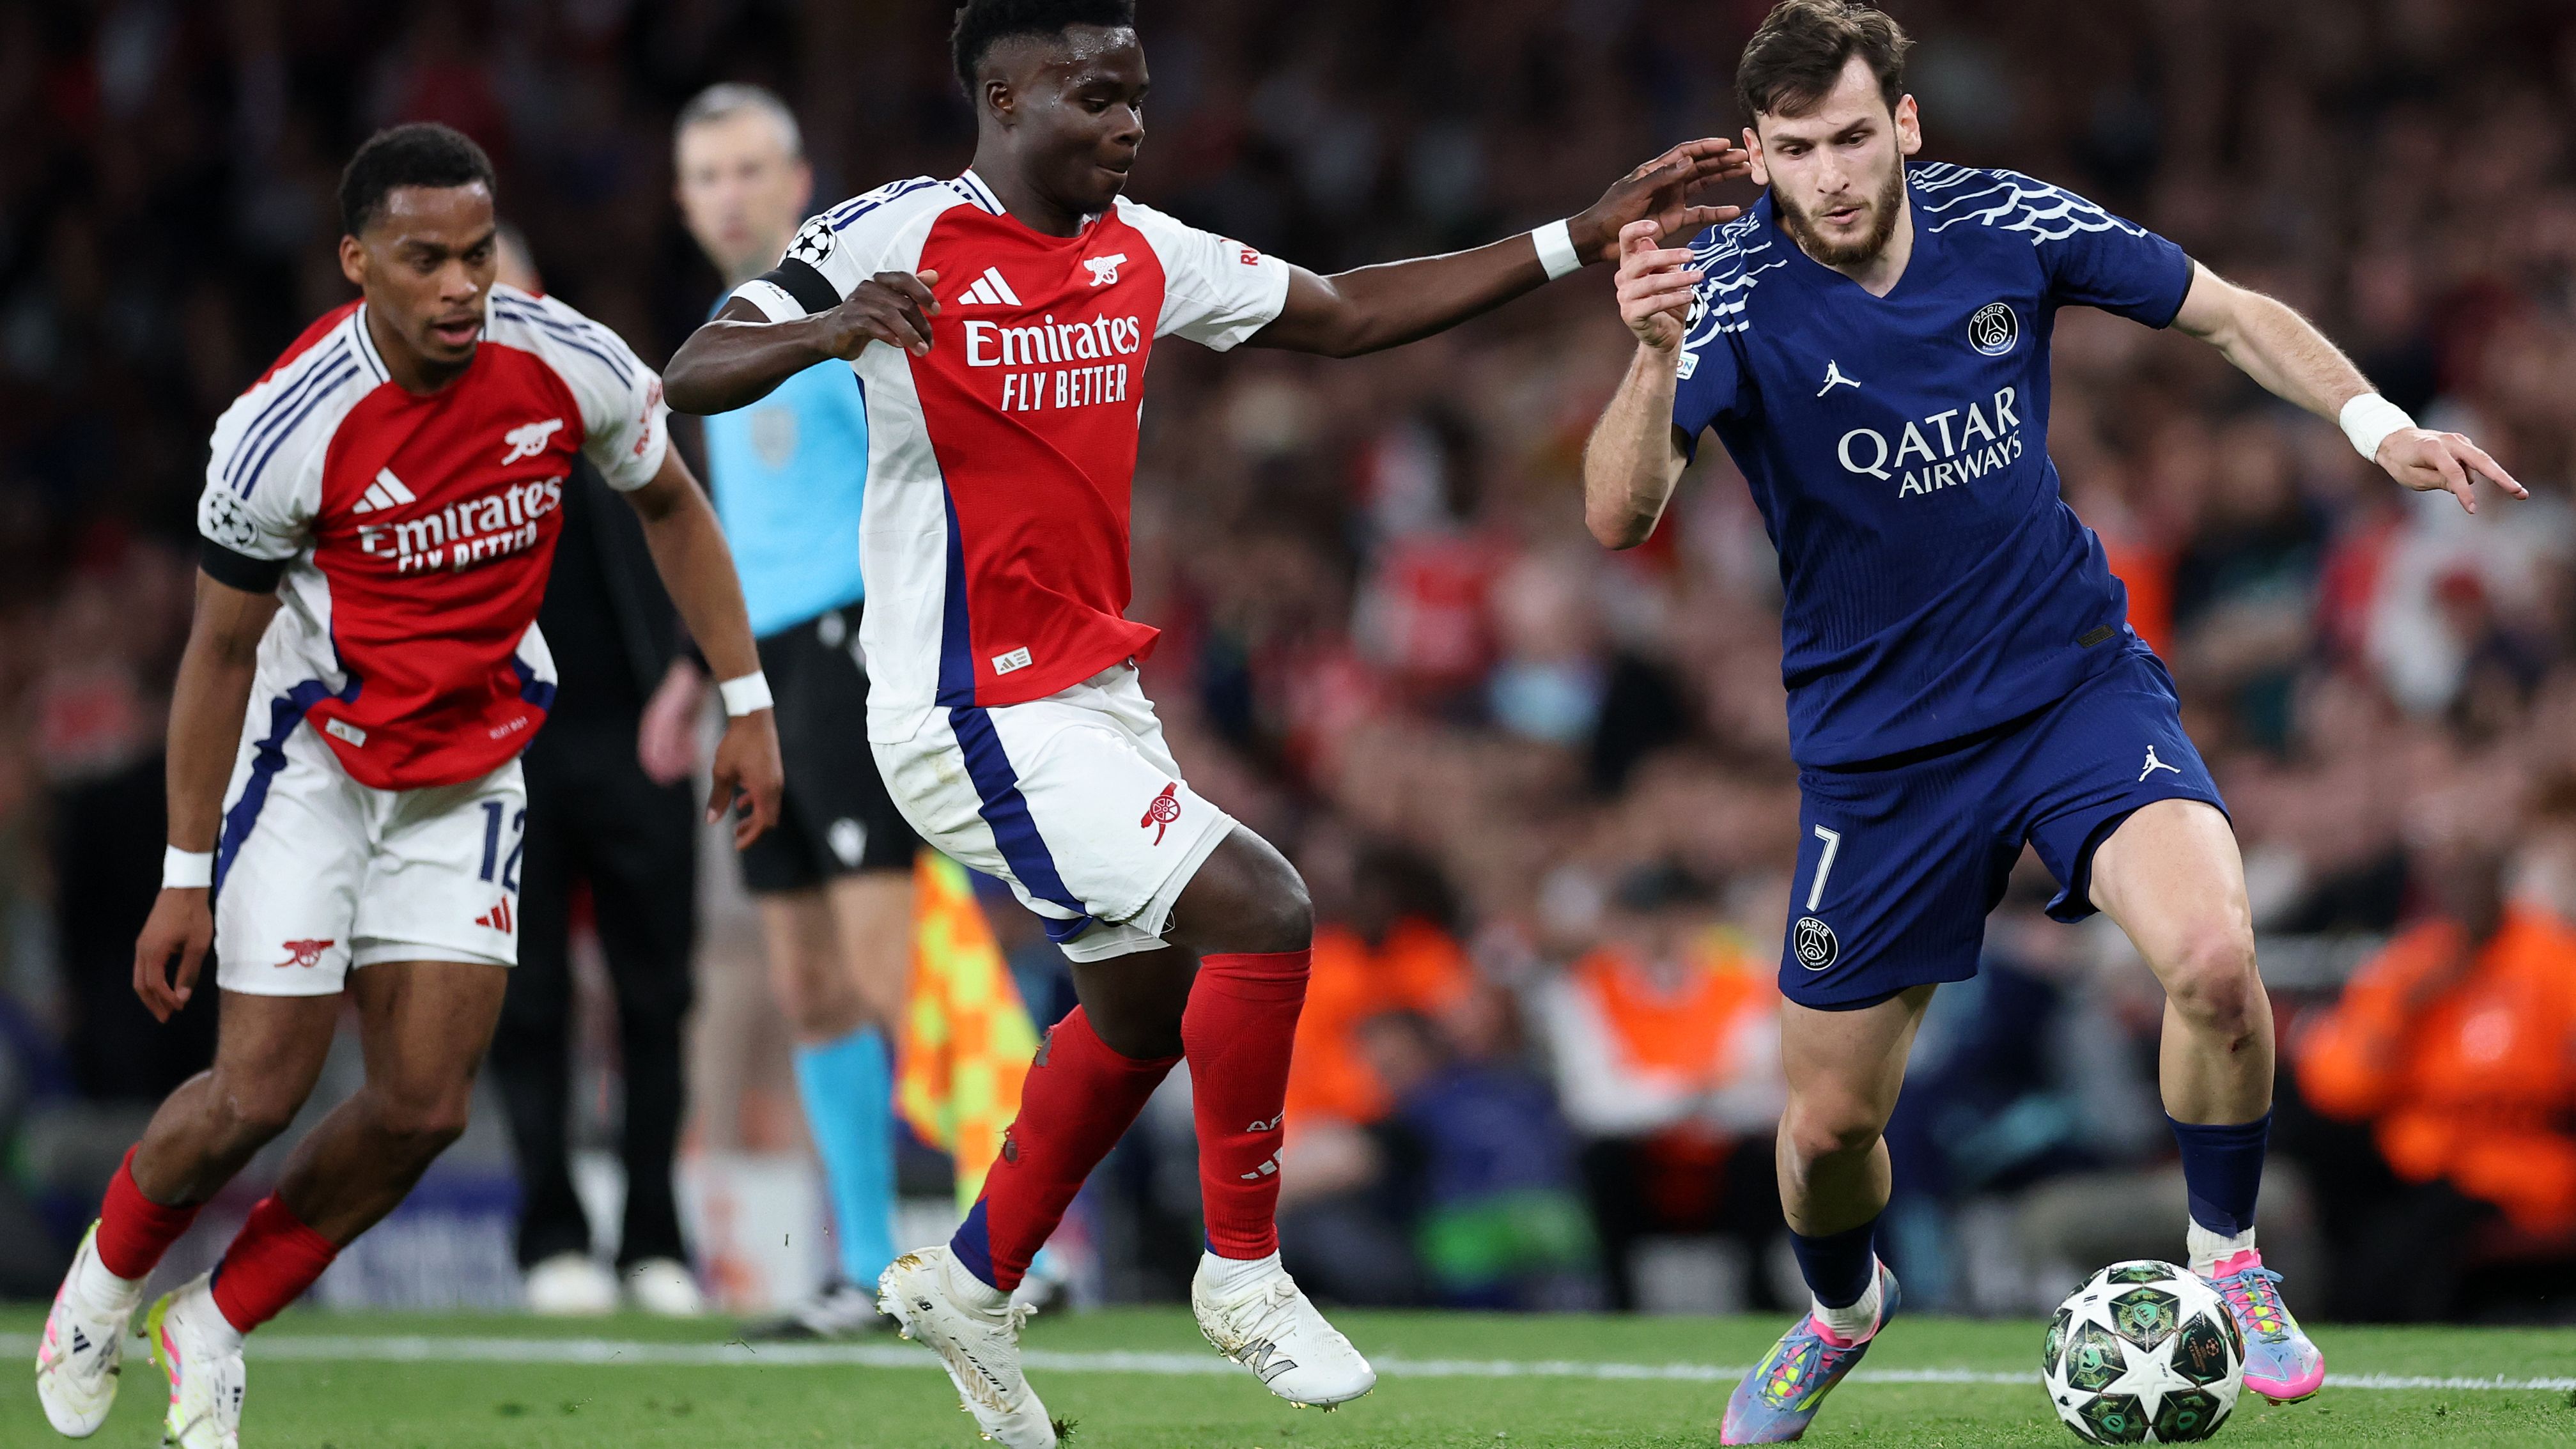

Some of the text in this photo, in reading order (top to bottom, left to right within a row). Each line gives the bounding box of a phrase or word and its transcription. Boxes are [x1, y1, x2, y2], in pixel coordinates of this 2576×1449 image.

[962, 312, 1140, 367] Emirates
[1973, 305, 2005, 324] PARIS
[1000, 363, 1128, 412] FLY BETTER
[1838, 386, 2021, 481] QATAR
[1898, 430, 2022, 499] AIRWAYS
[357, 476, 563, 558] Emirates
[479, 801, 527, 892] 12
[1806, 824, 1840, 912] 7
[1800, 920, 1829, 937] PARIS
[1246, 1106, 1284, 1132] AF
